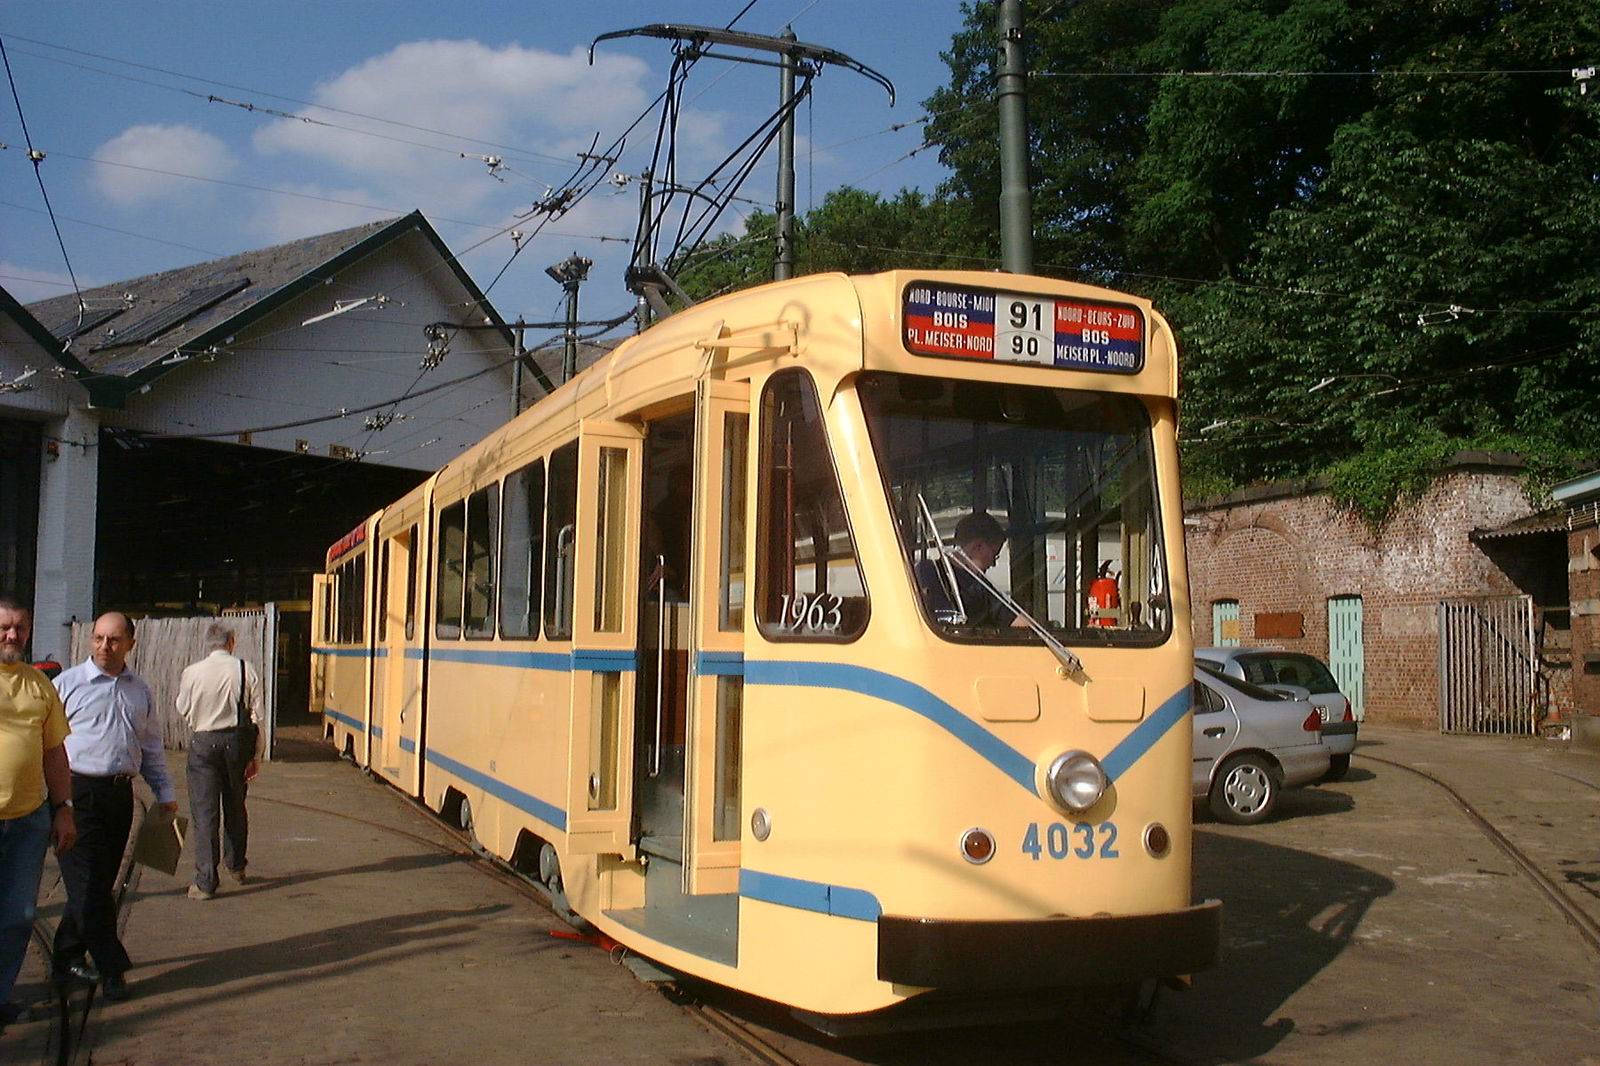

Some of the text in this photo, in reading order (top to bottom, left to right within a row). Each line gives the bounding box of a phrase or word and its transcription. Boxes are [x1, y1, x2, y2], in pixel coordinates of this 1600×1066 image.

[933, 310, 968, 329] BOIS
[1009, 301, 1042, 331] 91
[1011, 335, 1039, 357] 90
[1082, 328, 1110, 345] BOS
[1056, 344, 1089, 361] MEISER
[777, 592, 844, 633] 1963
[1022, 821, 1120, 861] 4032
